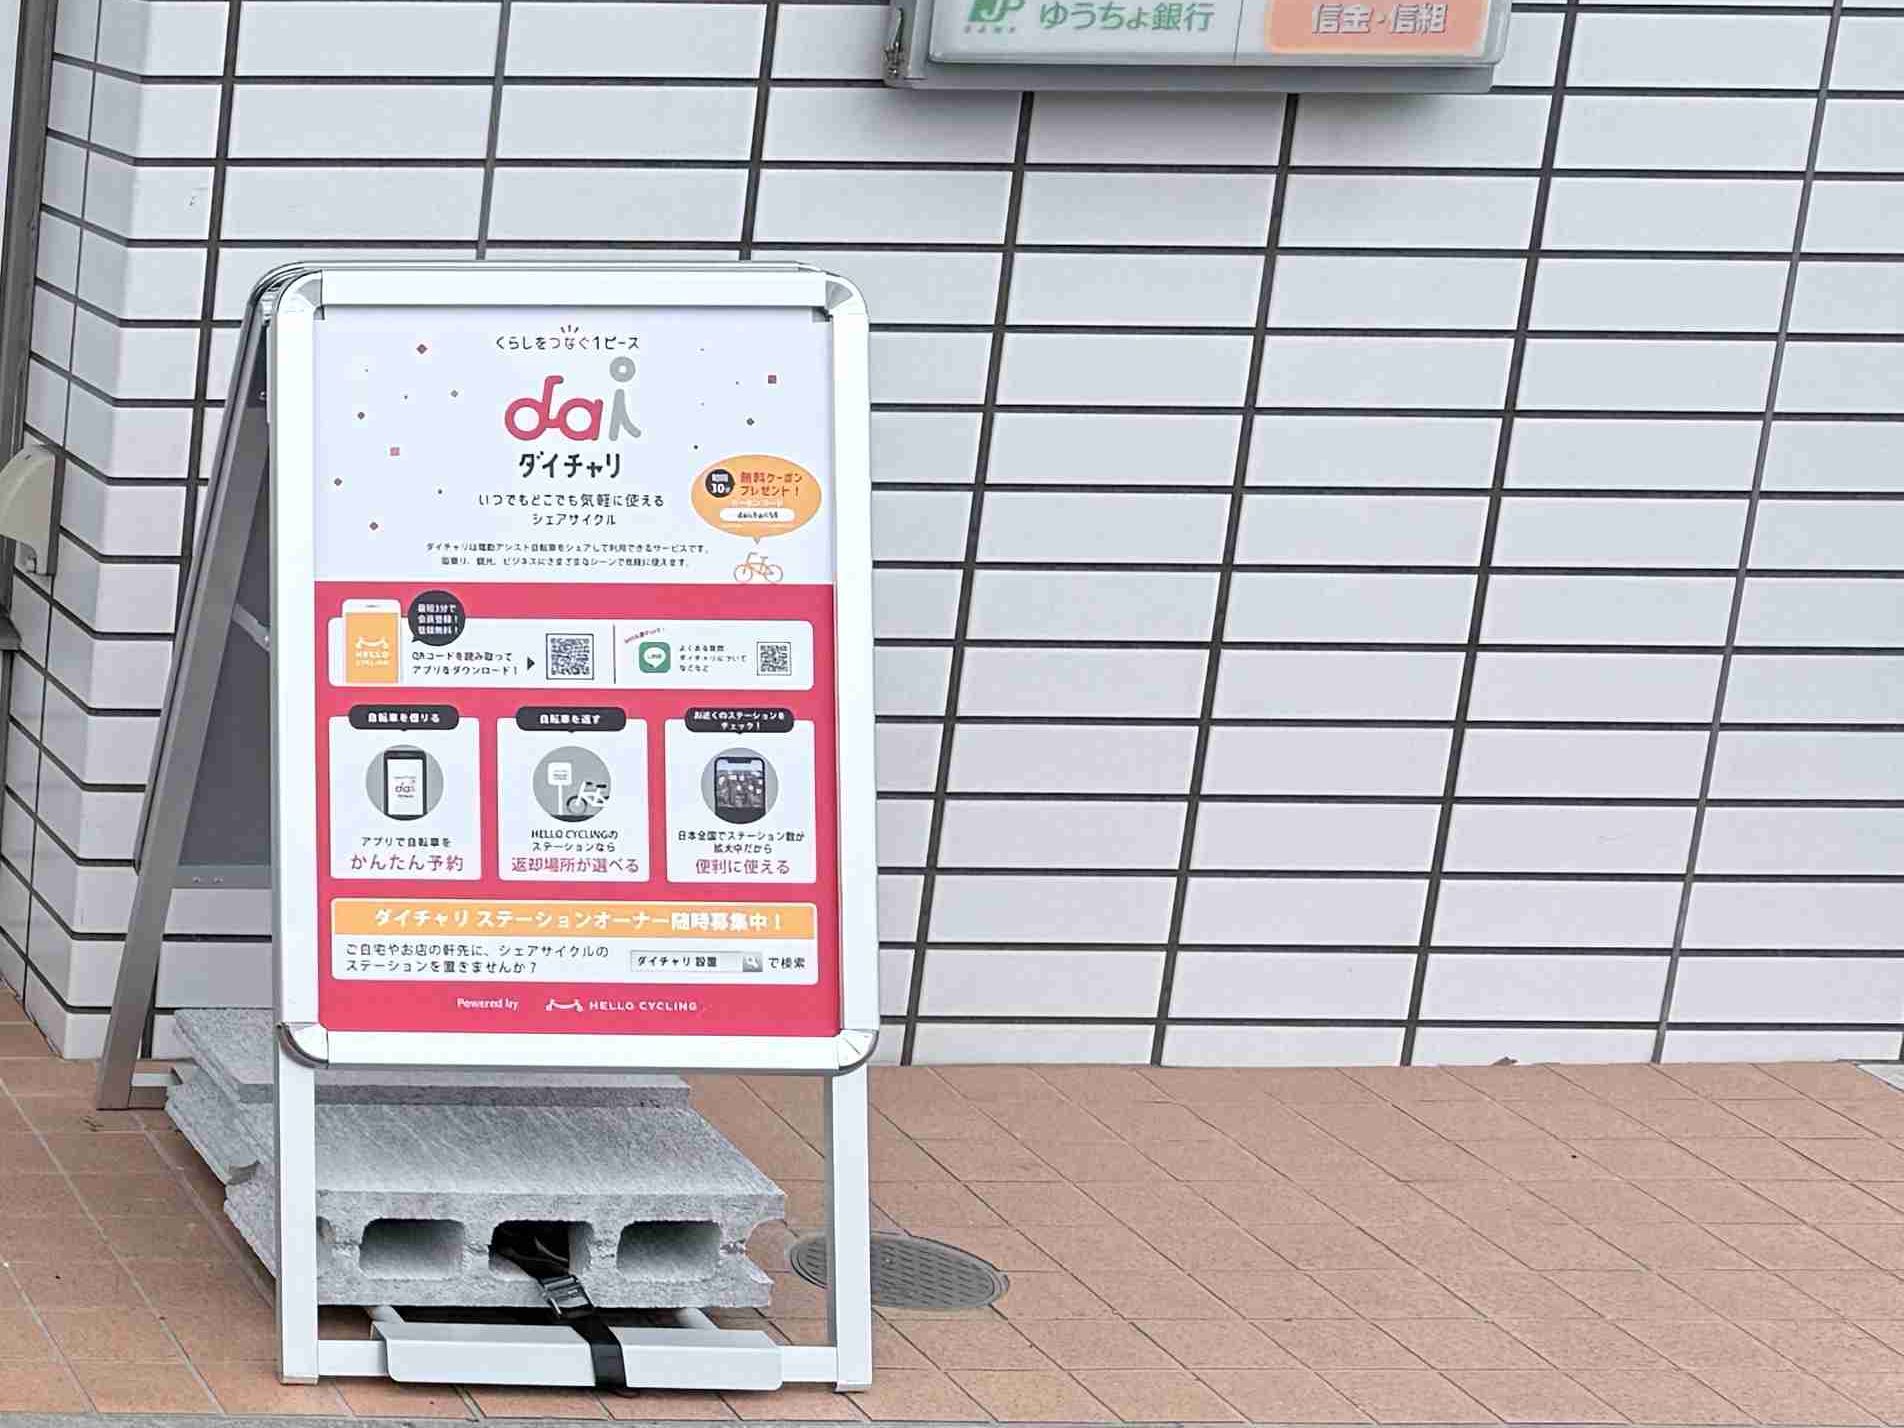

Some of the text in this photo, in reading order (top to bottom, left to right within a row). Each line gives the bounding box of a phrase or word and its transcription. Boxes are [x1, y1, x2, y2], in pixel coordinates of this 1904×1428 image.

[1039, 1, 1215, 31] ゆうちょ銀行
[1312, 3, 1448, 36] 信金・信組
[519, 450, 621, 479] ダイチャリ
[479, 492, 664, 508] いつでもどこでも気軽に使える
[533, 513, 616, 526] シェアサイクル
[350, 853, 464, 872] かんたん予約
[695, 857, 792, 876] 便利に使える
[456, 996, 503, 1009] Powered
[589, 1001, 699, 1012] HELLO CYCLING
